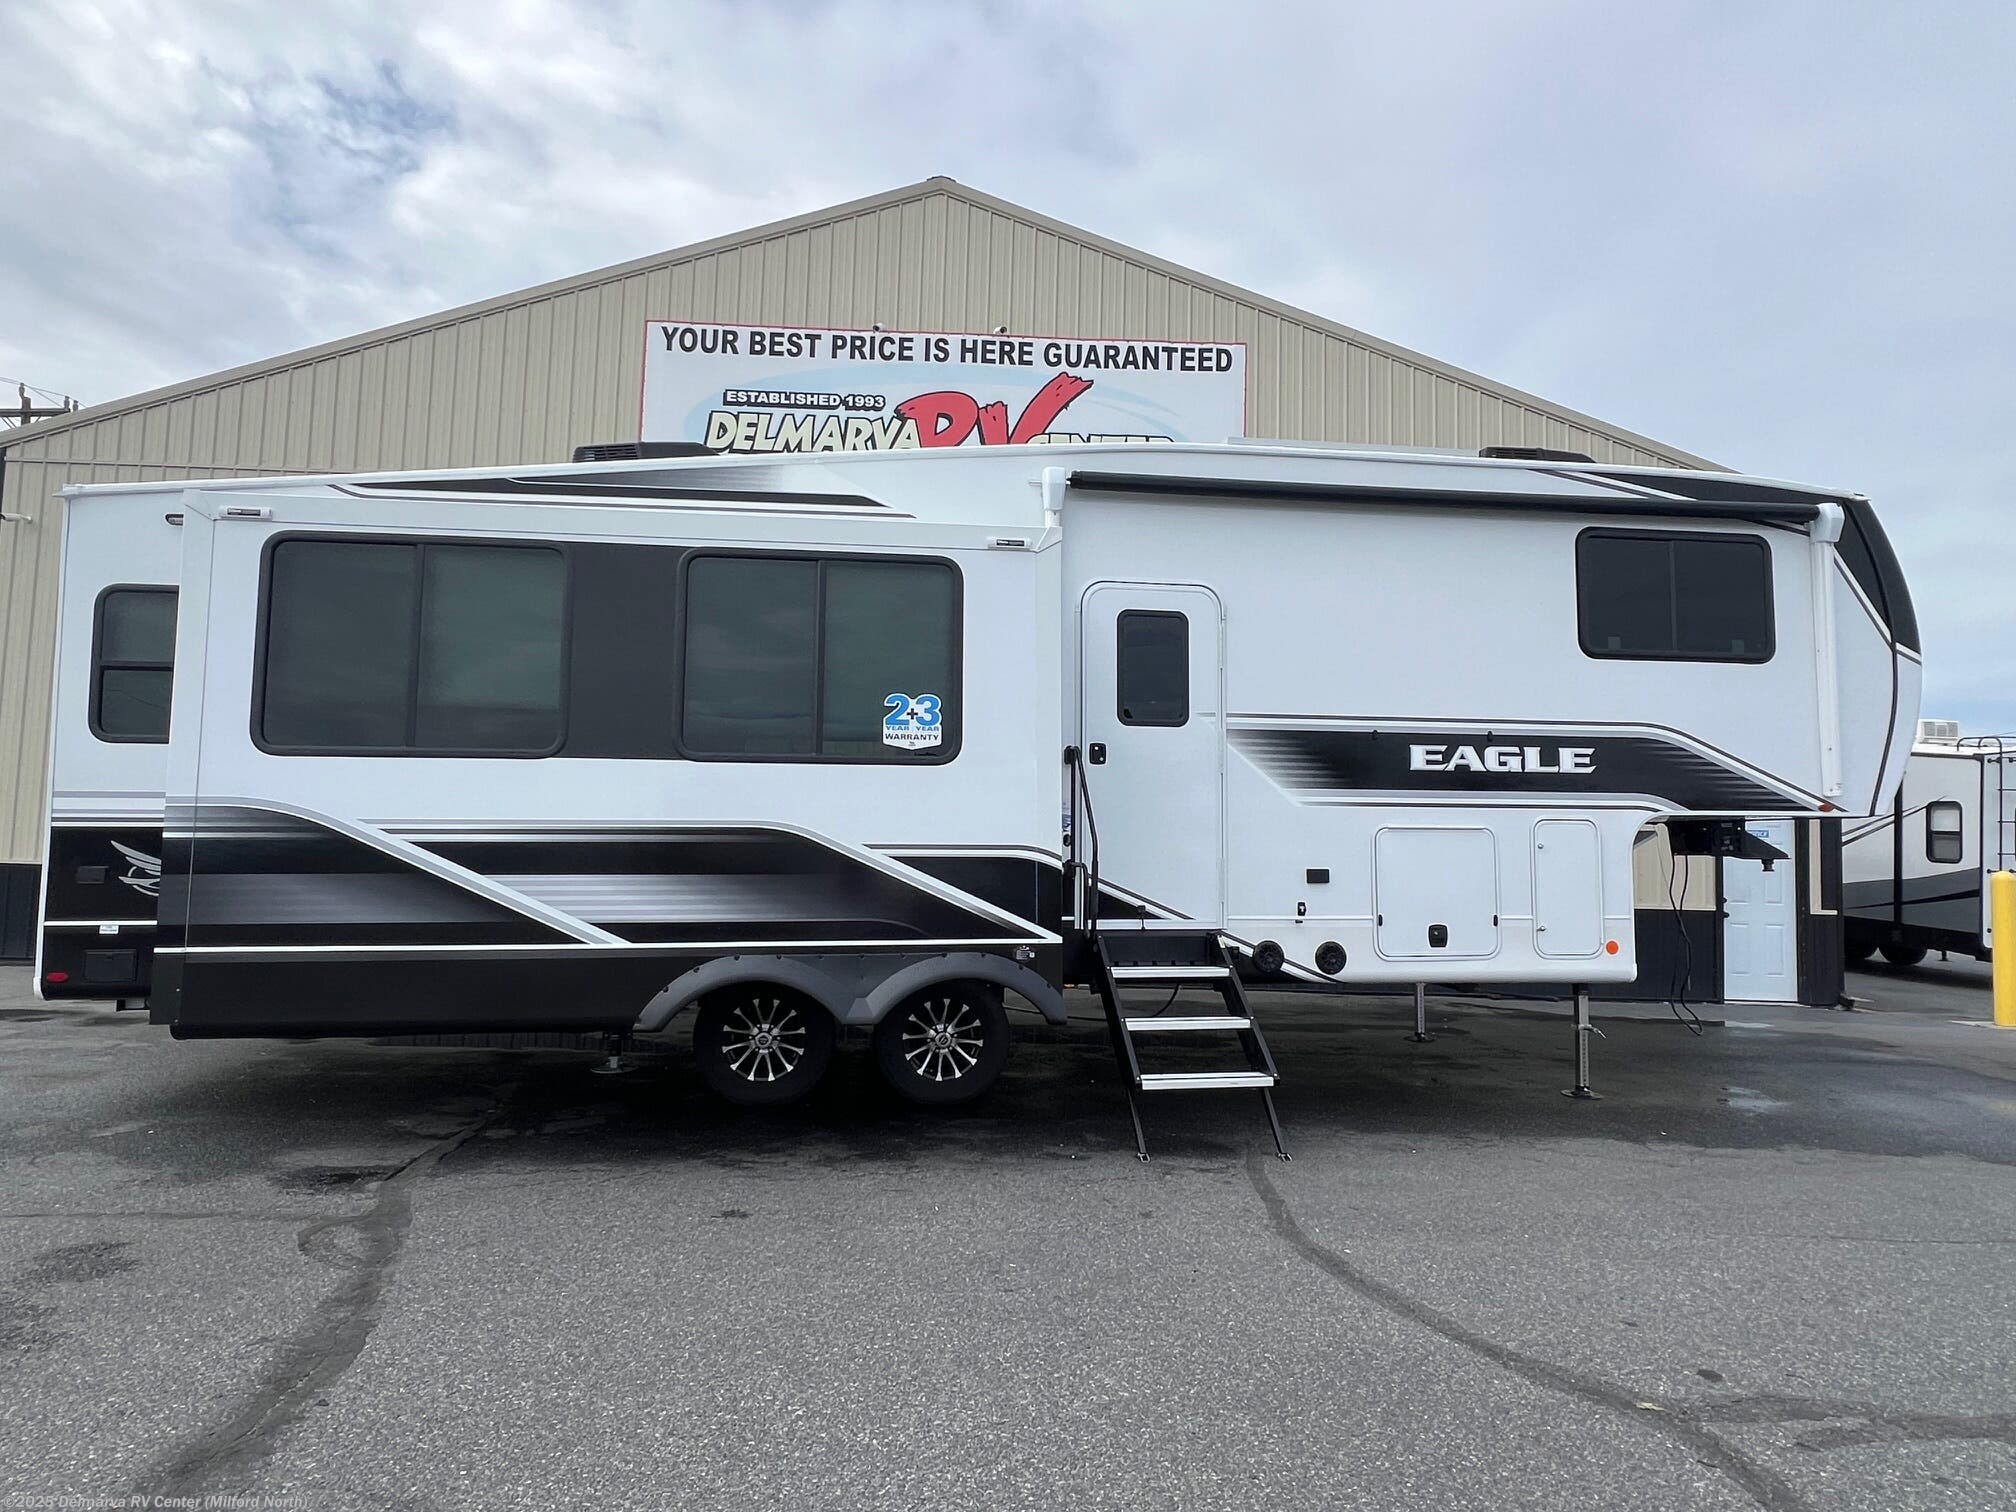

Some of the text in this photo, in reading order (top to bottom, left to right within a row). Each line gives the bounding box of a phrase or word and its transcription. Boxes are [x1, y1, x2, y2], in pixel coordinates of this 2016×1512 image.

[661, 326, 1233, 372] YOUR BEST PRICE IS HERE GUARANTEED
[725, 390, 885, 408] ESTABLISHED 1993
[705, 411, 922, 452] DELMARVA
[885, 733, 939, 741] WARRANTY
[1409, 744, 1597, 774] EAGLE
